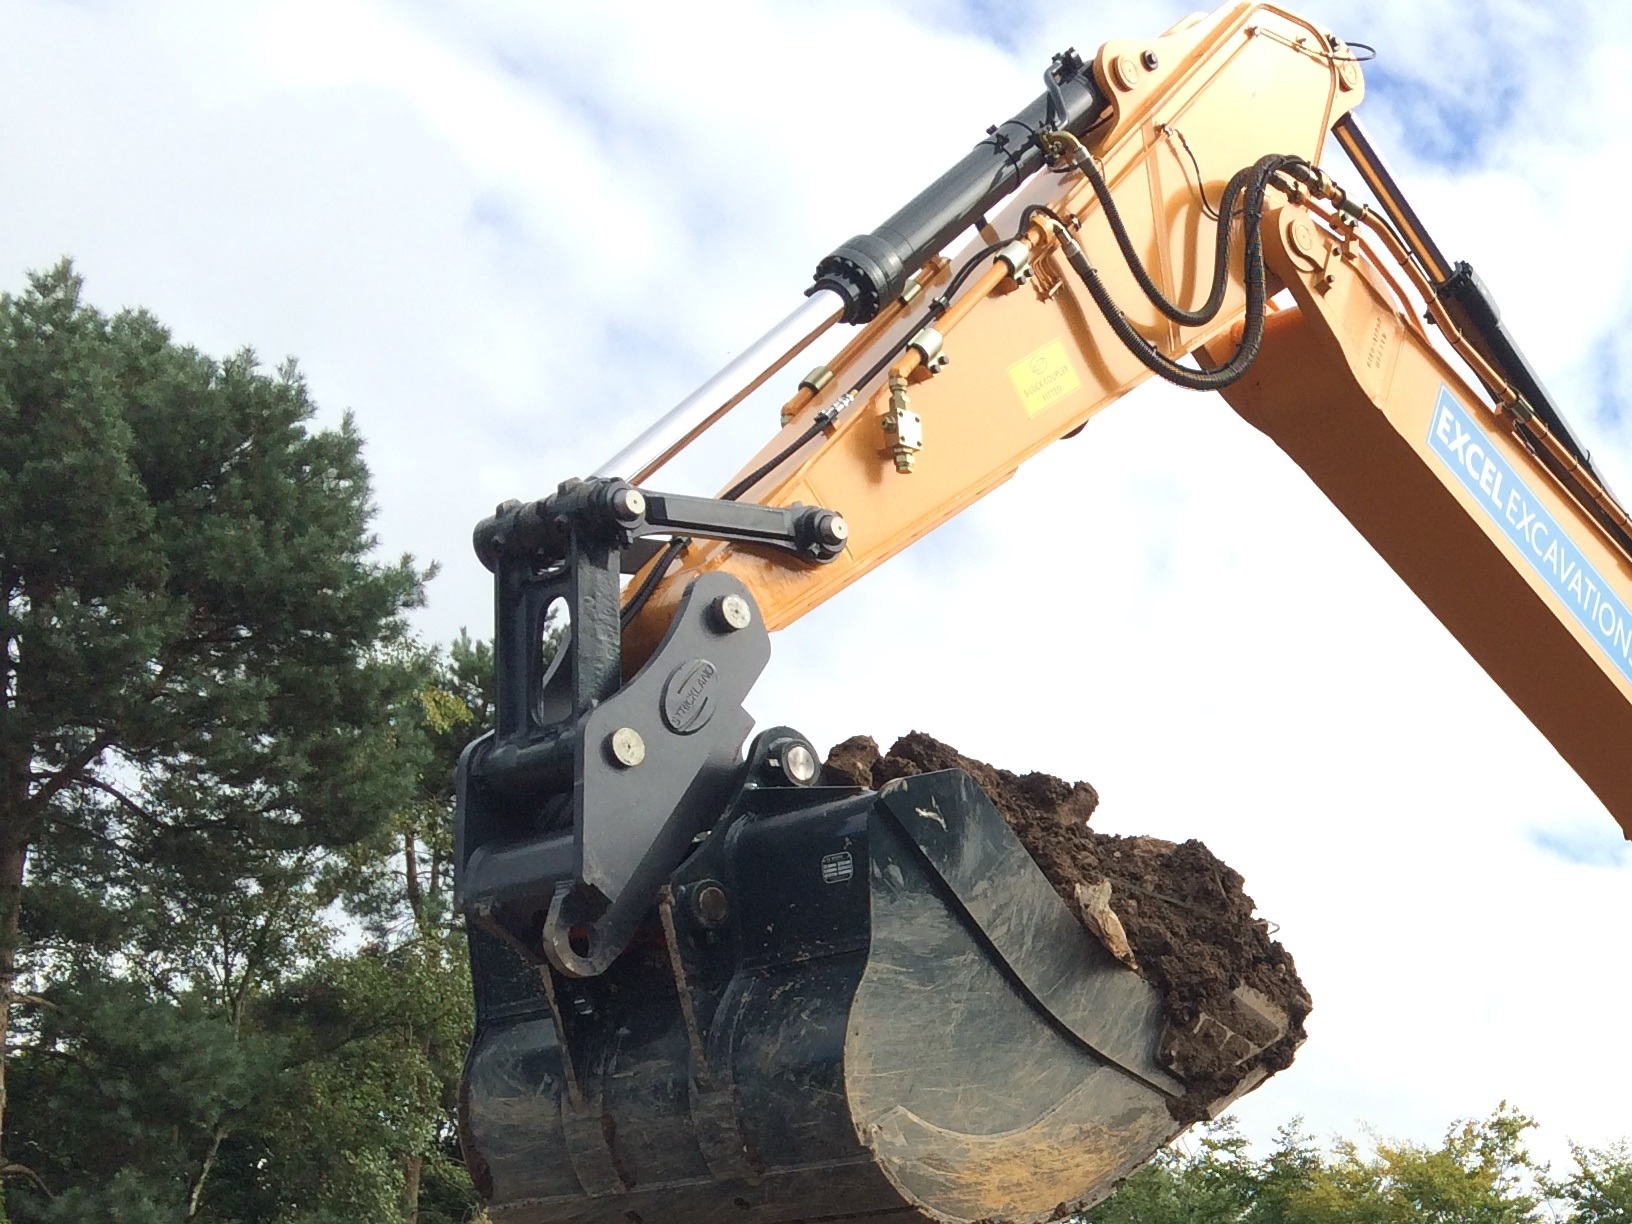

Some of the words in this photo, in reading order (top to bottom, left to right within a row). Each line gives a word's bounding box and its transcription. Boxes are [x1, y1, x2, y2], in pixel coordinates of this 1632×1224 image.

[1042, 386, 1062, 401] FITTED
[1043, 365, 1068, 386] COUPLER
[1436, 405, 1504, 509] EXCEL
[672, 664, 715, 726] STRICKLAND
